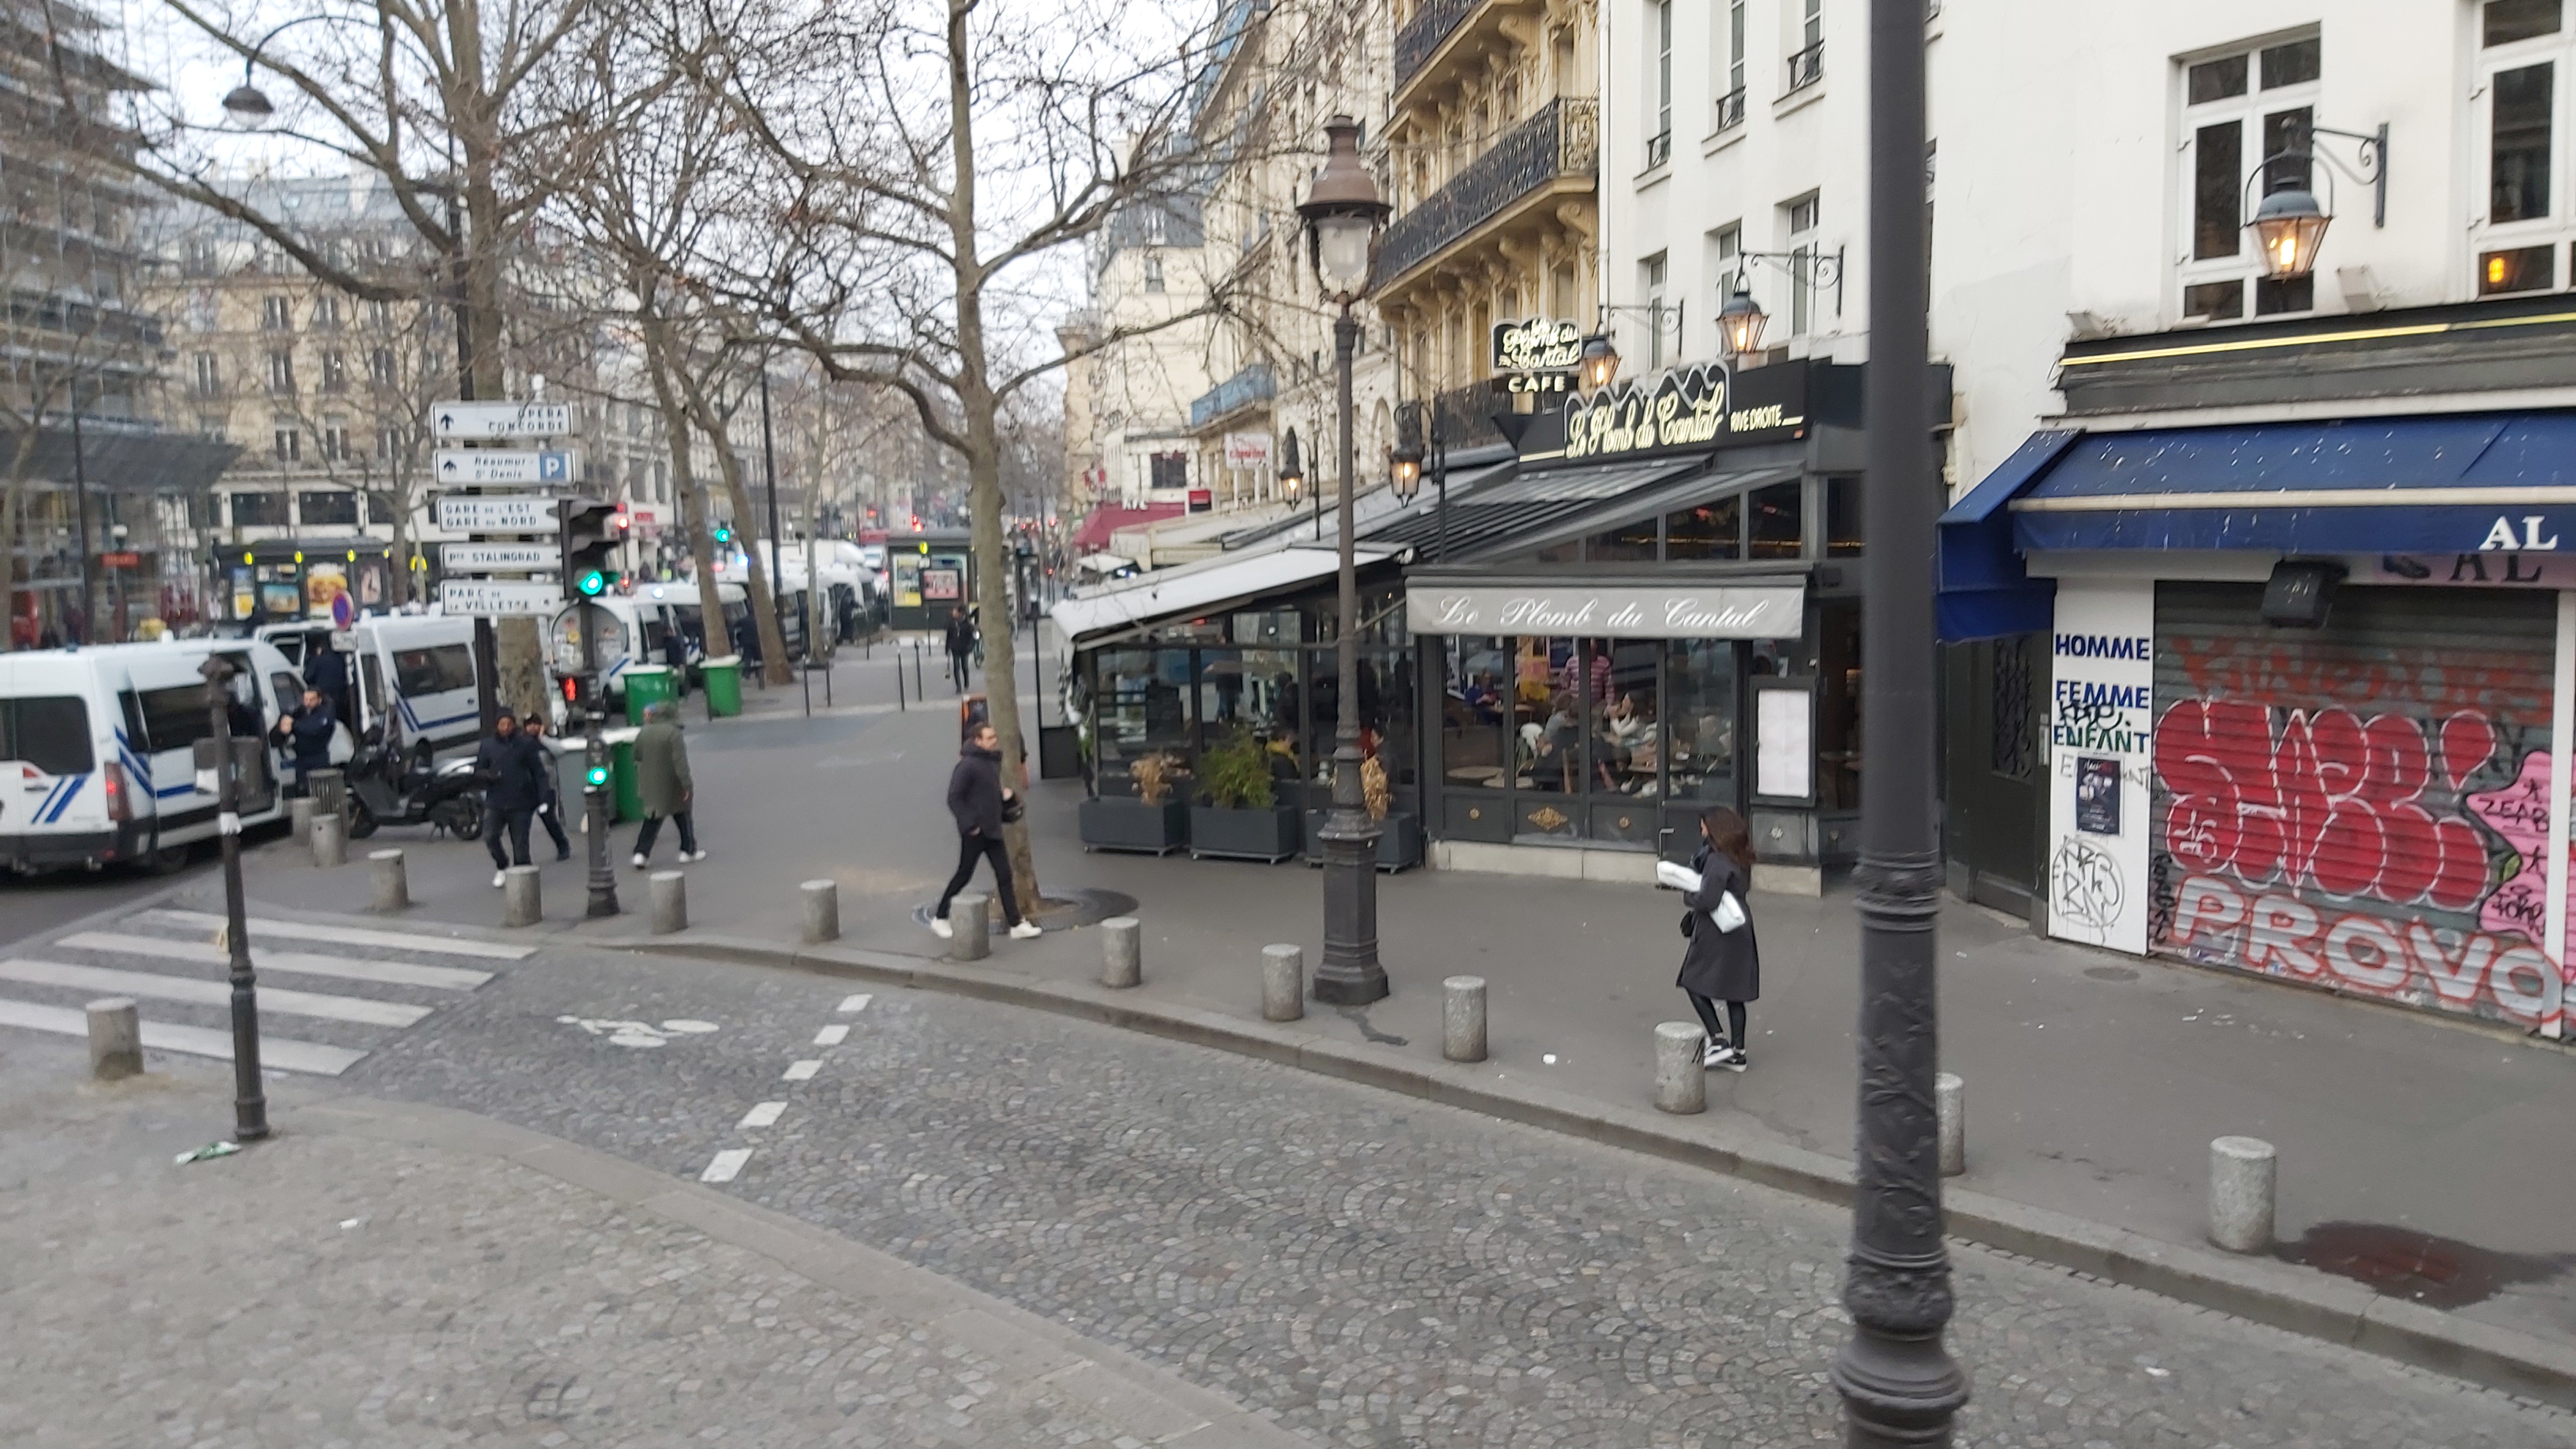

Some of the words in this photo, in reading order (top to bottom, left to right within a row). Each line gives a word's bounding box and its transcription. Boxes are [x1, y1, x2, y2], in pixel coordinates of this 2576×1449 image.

[1511, 343, 1579, 369] Cantal
[487, 420, 564, 432] CONCORDE
[1567, 409, 1588, 459] Le
[1588, 399, 1637, 456] Plomb
[1635, 396, 1655, 450] du
[1656, 381, 1724, 446] Cantal
[1730, 411, 1749, 433] RIVE
[1749, 404, 1782, 431] DROITE
[546, 456, 560, 477] P
[445, 504, 477, 514] GARE
[447, 517, 479, 527] GARE
[501, 516, 537, 526] NORD
[2478, 515, 2559, 551] AL
[472, 551, 540, 562] STALINGRAD
[450, 588, 484, 598] PARC
[1432, 596, 1480, 627] Le
[1499, 597, 1599, 627] Plomb
[1606, 600, 1644, 628] du
[1664, 597, 1769, 629] Cantal
[2055, 633, 2150, 661] HOMME
[2055, 679, 2150, 709] FEMME
[2053, 724, 2150, 754] ENFANT
